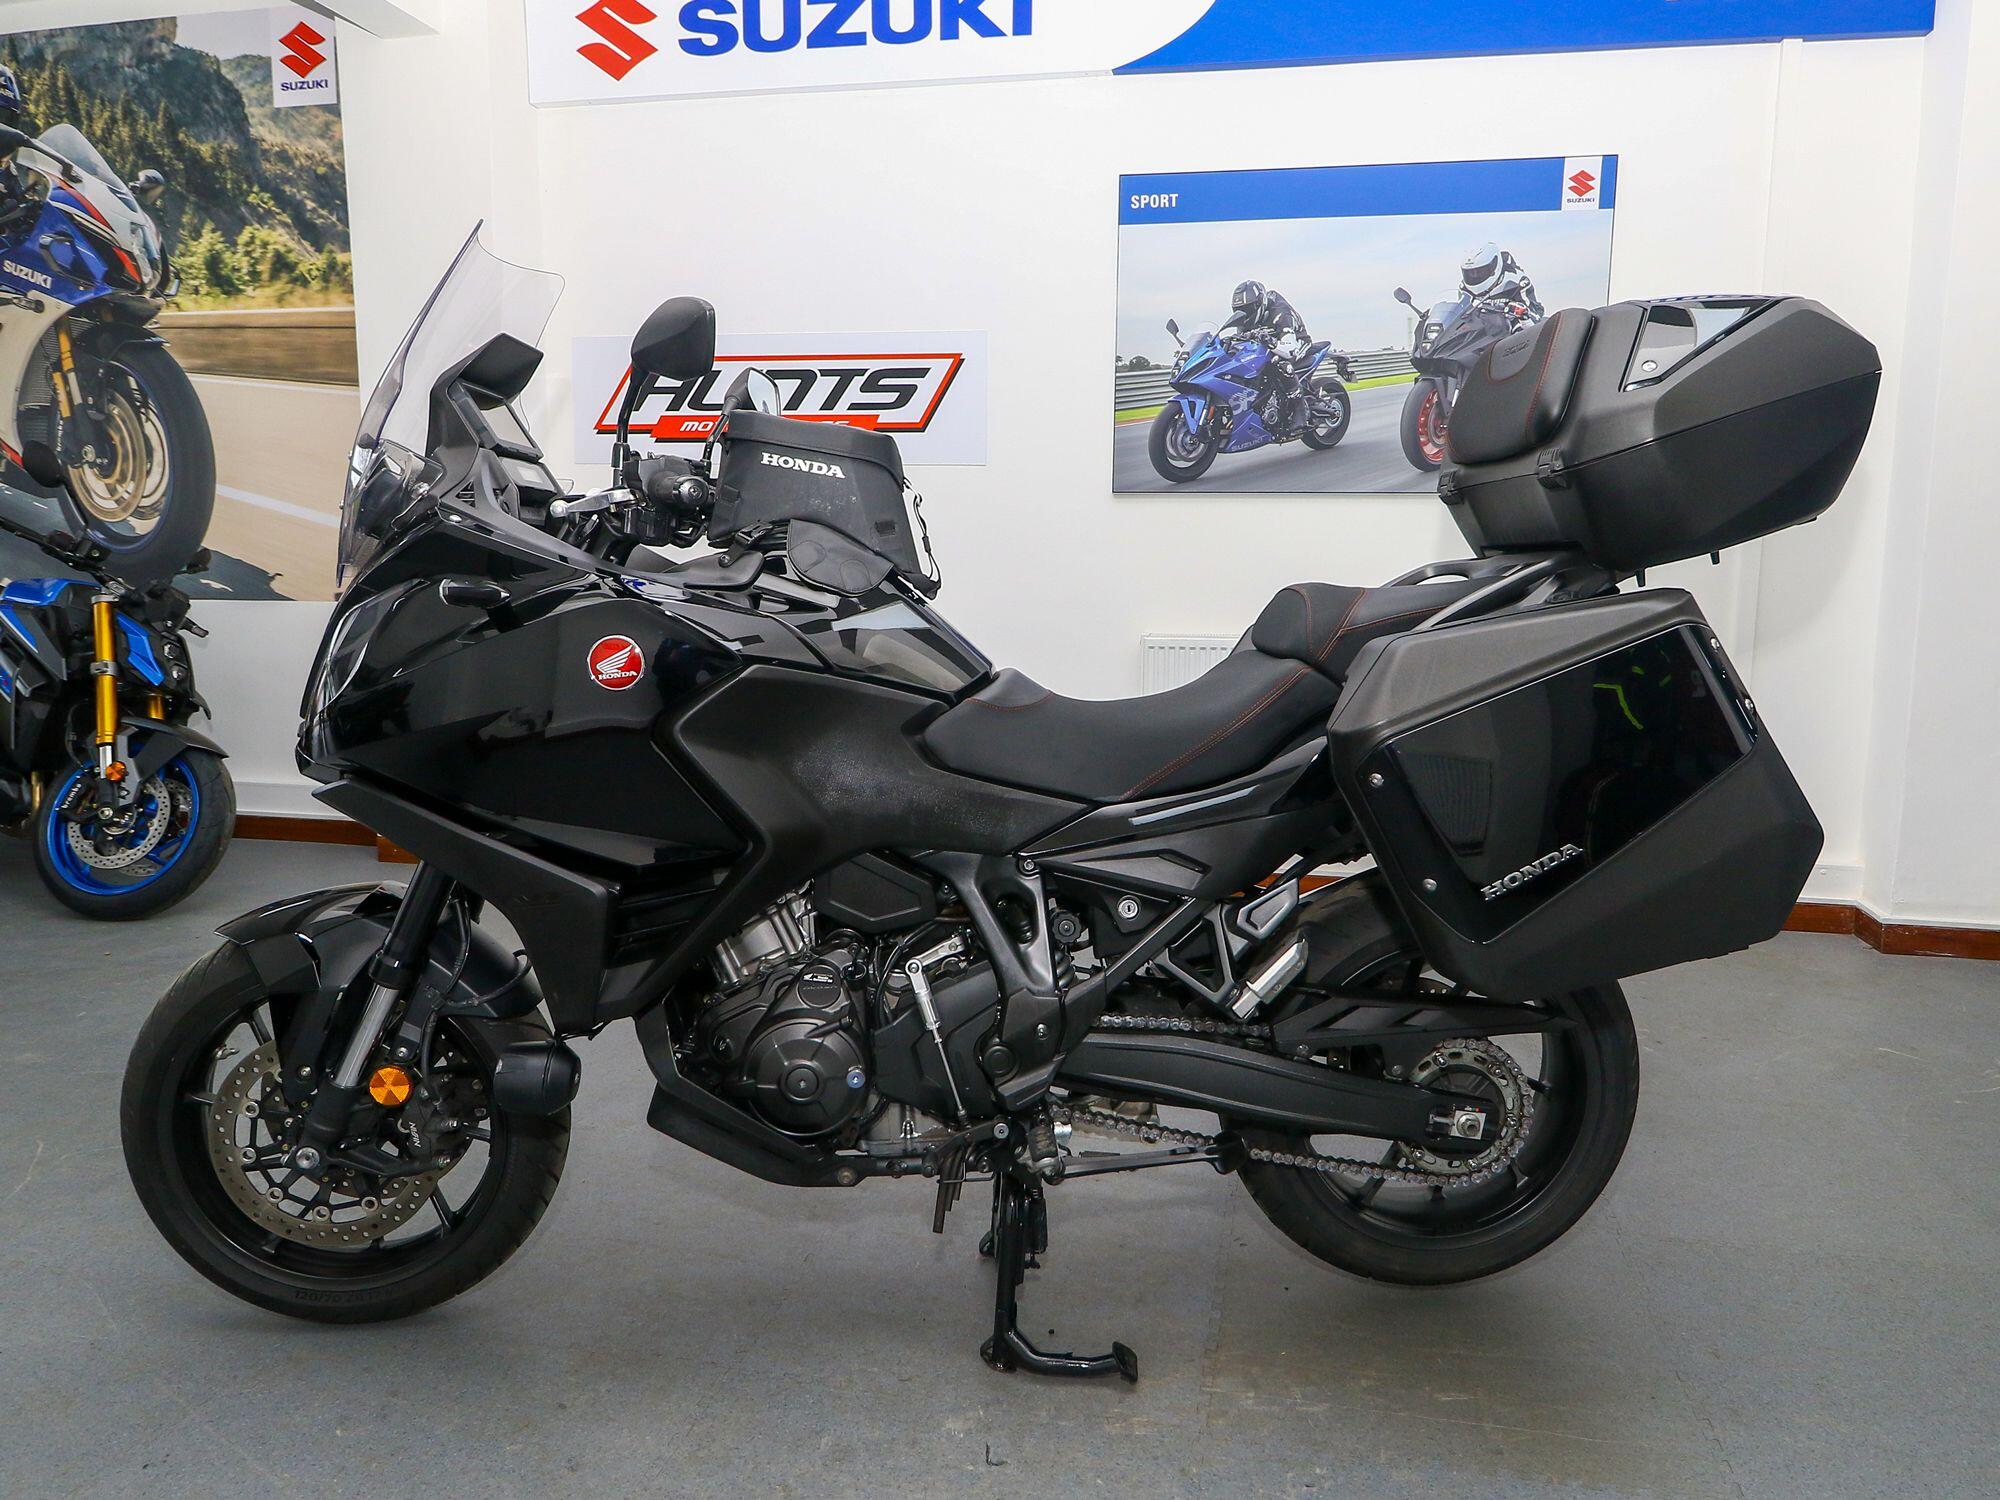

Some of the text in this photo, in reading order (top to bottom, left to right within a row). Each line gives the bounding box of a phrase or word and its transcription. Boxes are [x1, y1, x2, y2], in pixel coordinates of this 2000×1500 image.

[678, 0, 1033, 56] SUZUKI
[281, 79, 328, 91] SUZUKI
[1131, 193, 1178, 209] SPORT
[3, 260, 52, 290] SUZUKI
[760, 452, 845, 479] HONDA
[598, 671, 637, 680] HONDA
[1480, 843, 1583, 901] HONDA
